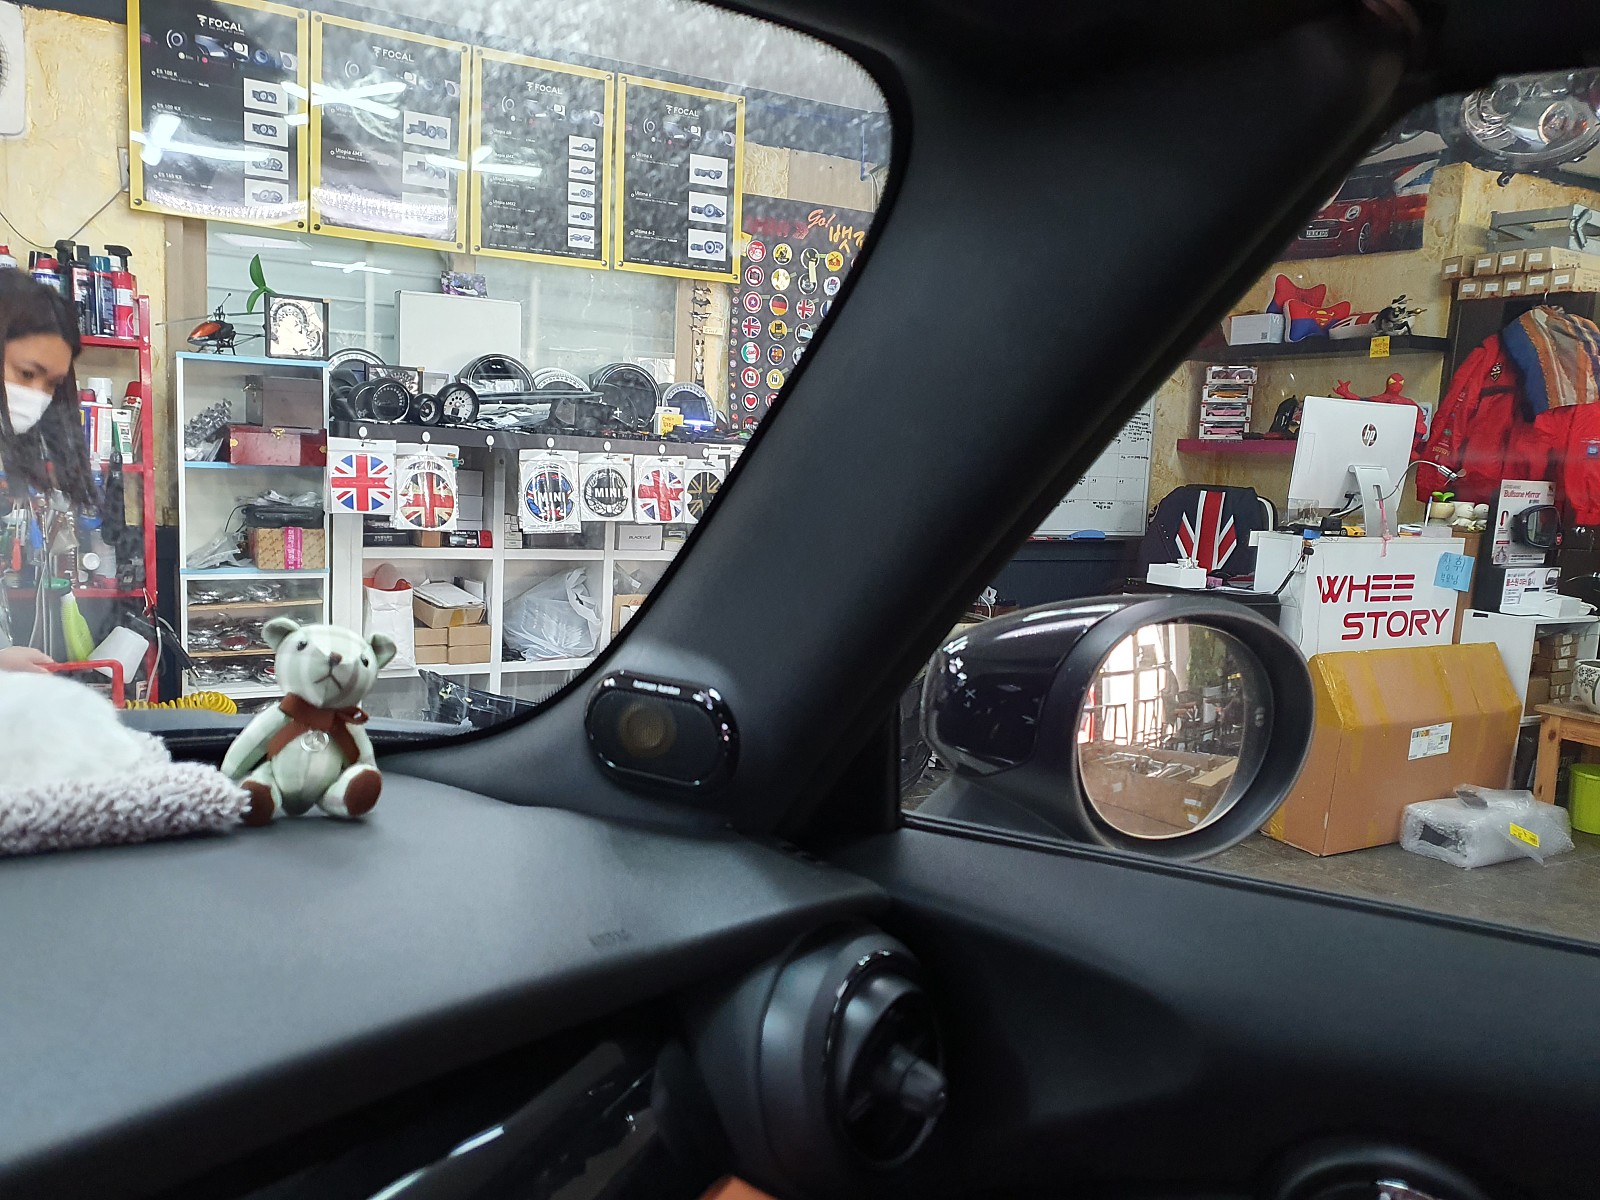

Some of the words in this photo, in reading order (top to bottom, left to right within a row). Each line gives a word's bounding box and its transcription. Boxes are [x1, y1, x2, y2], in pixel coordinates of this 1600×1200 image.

[208, 17, 245, 33] FOCAL
[382, 48, 415, 62] FOCAL
[534, 83, 563, 95] FOCAL
[673, 106, 699, 117] FOCAL
[807, 208, 837, 229] Go!
[747, 373, 755, 382] hi
[771, 374, 779, 383] hi
[1362, 423, 1377, 447] hp
[538, 491, 566, 502] MINI
[594, 487, 621, 498] MINI
[1341, 608, 1450, 641] STORY
